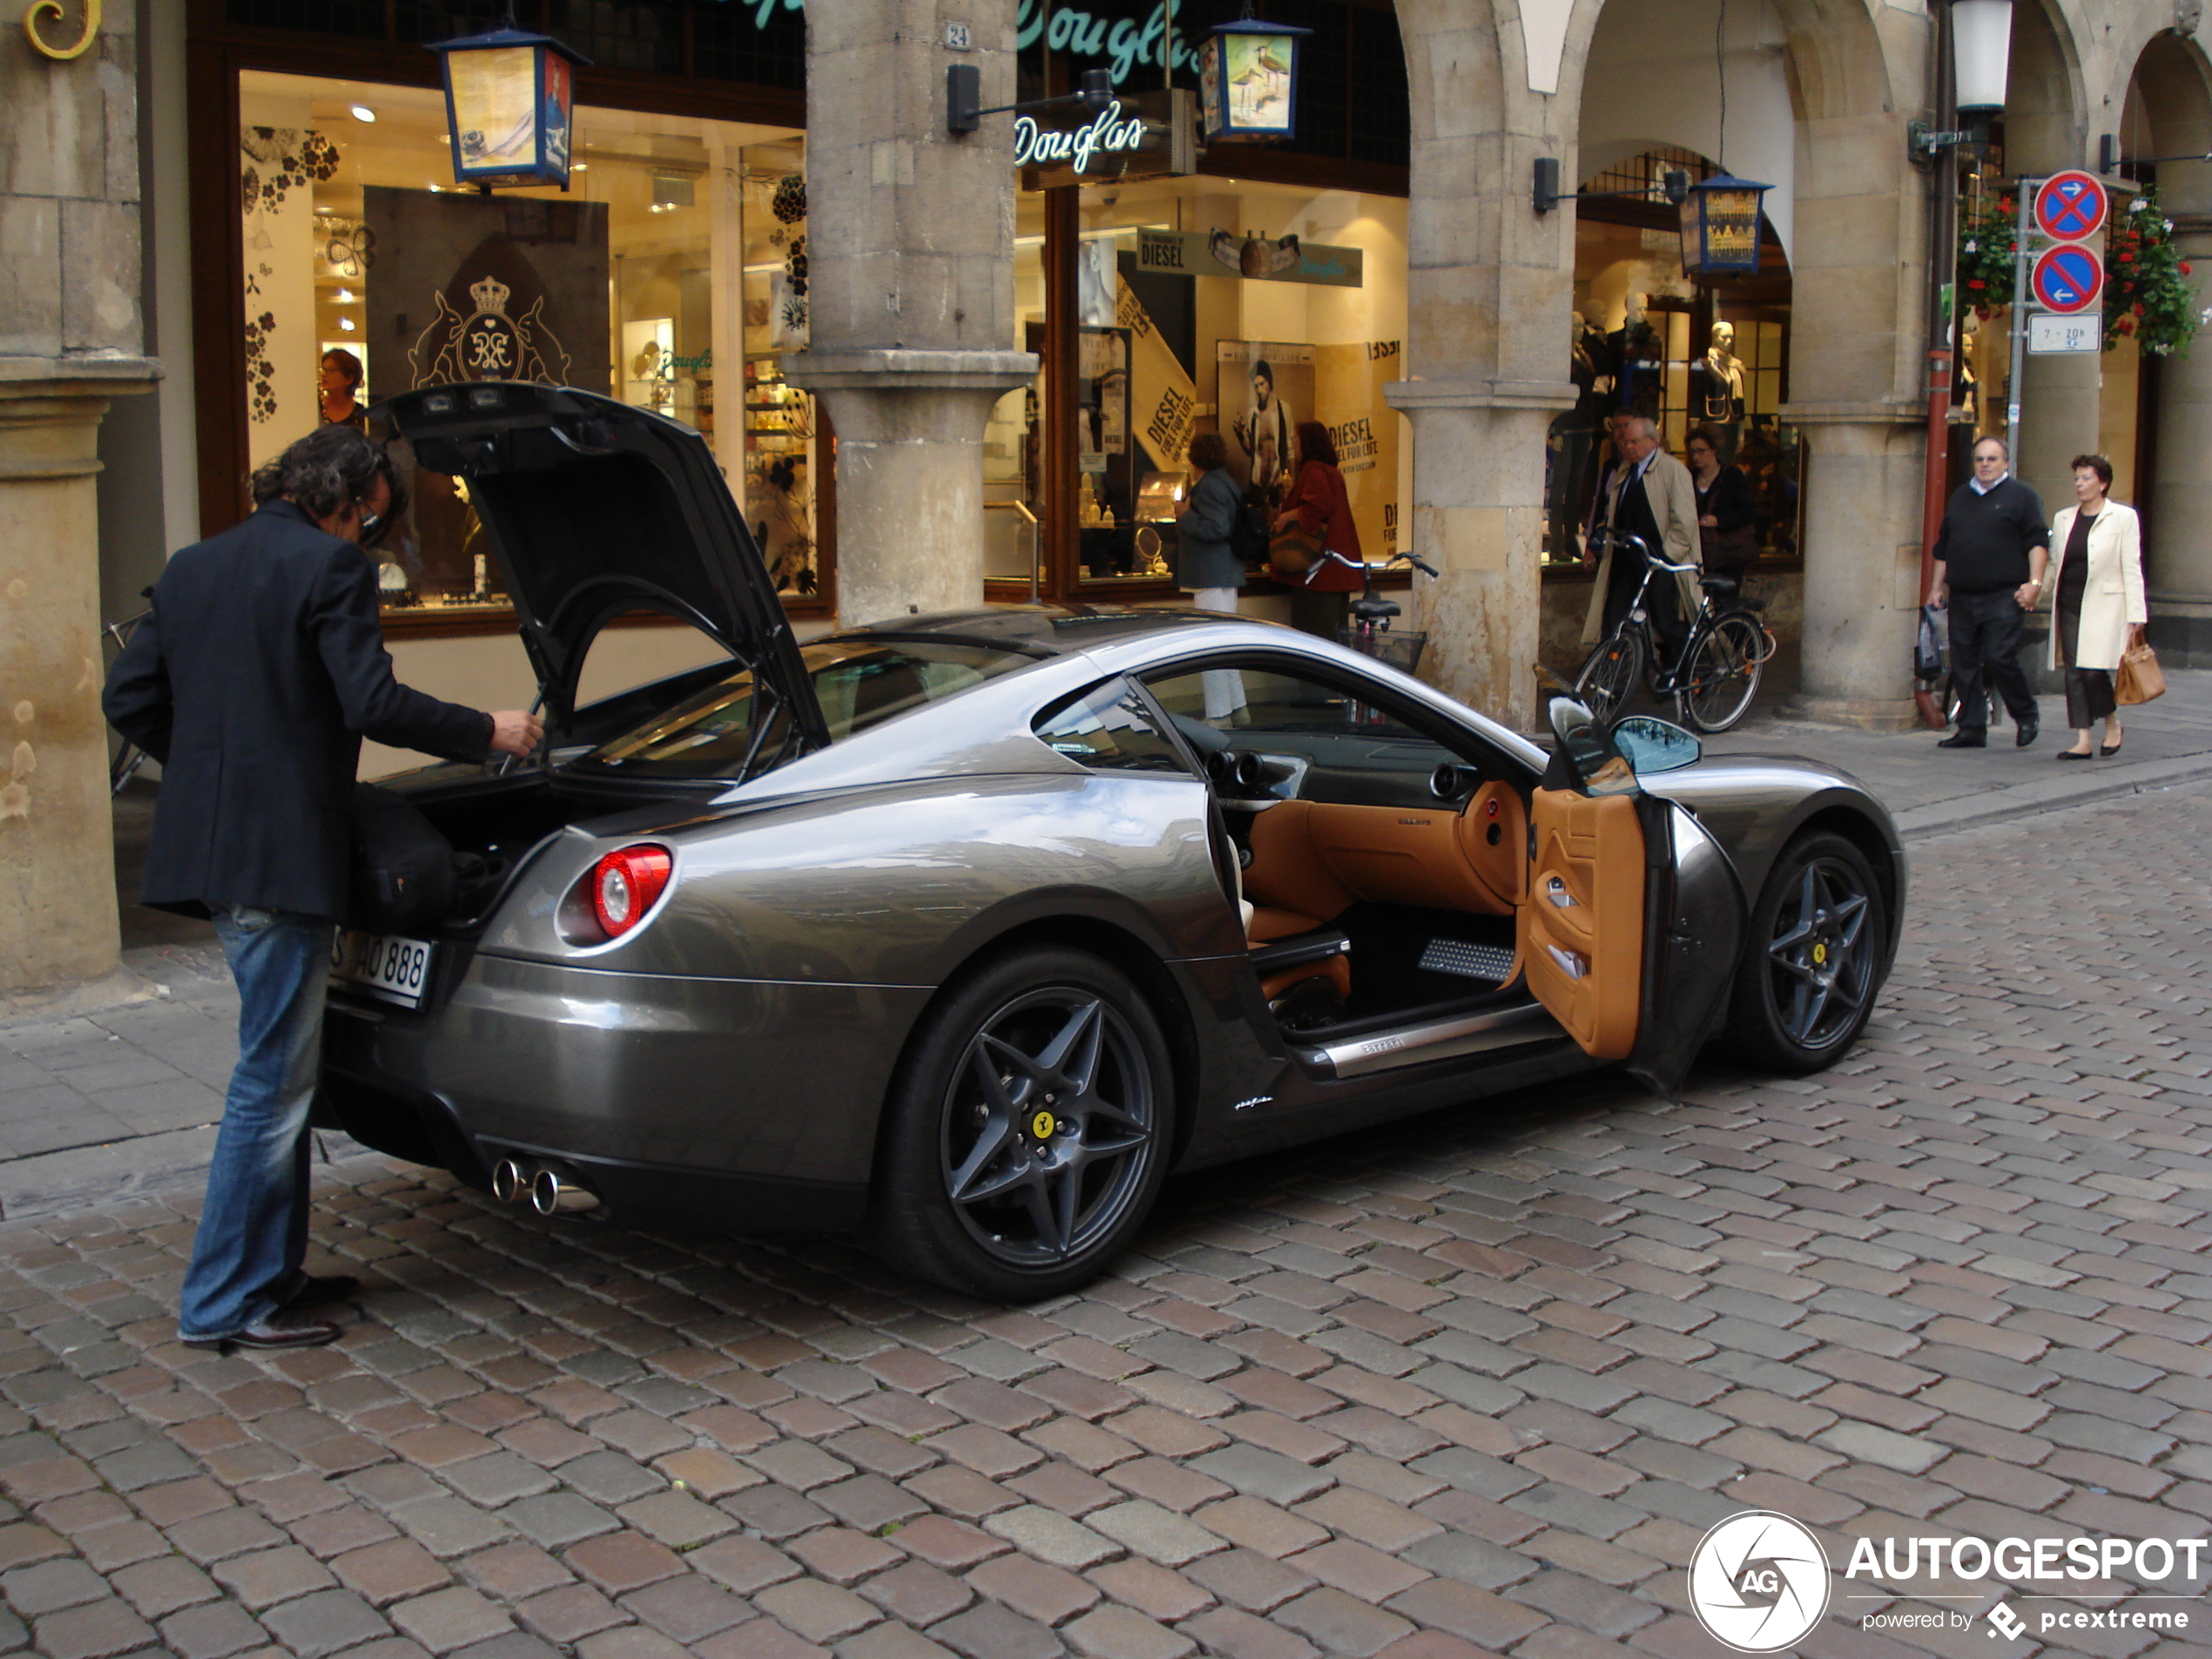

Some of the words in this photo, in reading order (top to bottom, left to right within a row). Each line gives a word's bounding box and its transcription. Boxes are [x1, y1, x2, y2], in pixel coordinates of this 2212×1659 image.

[950, 25, 967, 46] 24
[1015, 100, 1148, 174] Douglas
[1142, 244, 1184, 267] DIESEL
[2044, 328, 2051, 339] 7
[1147, 387, 1184, 446] DIESEL
[1160, 434, 1177, 457] FUEL
[1170, 415, 1184, 436] FOR
[1179, 396, 1195, 418] LIFE
[1328, 418, 1373, 448] DIESEL
[1347, 444, 1361, 460] FOR
[1362, 441, 1379, 456] LIFE
[384, 942, 424, 988] 888
